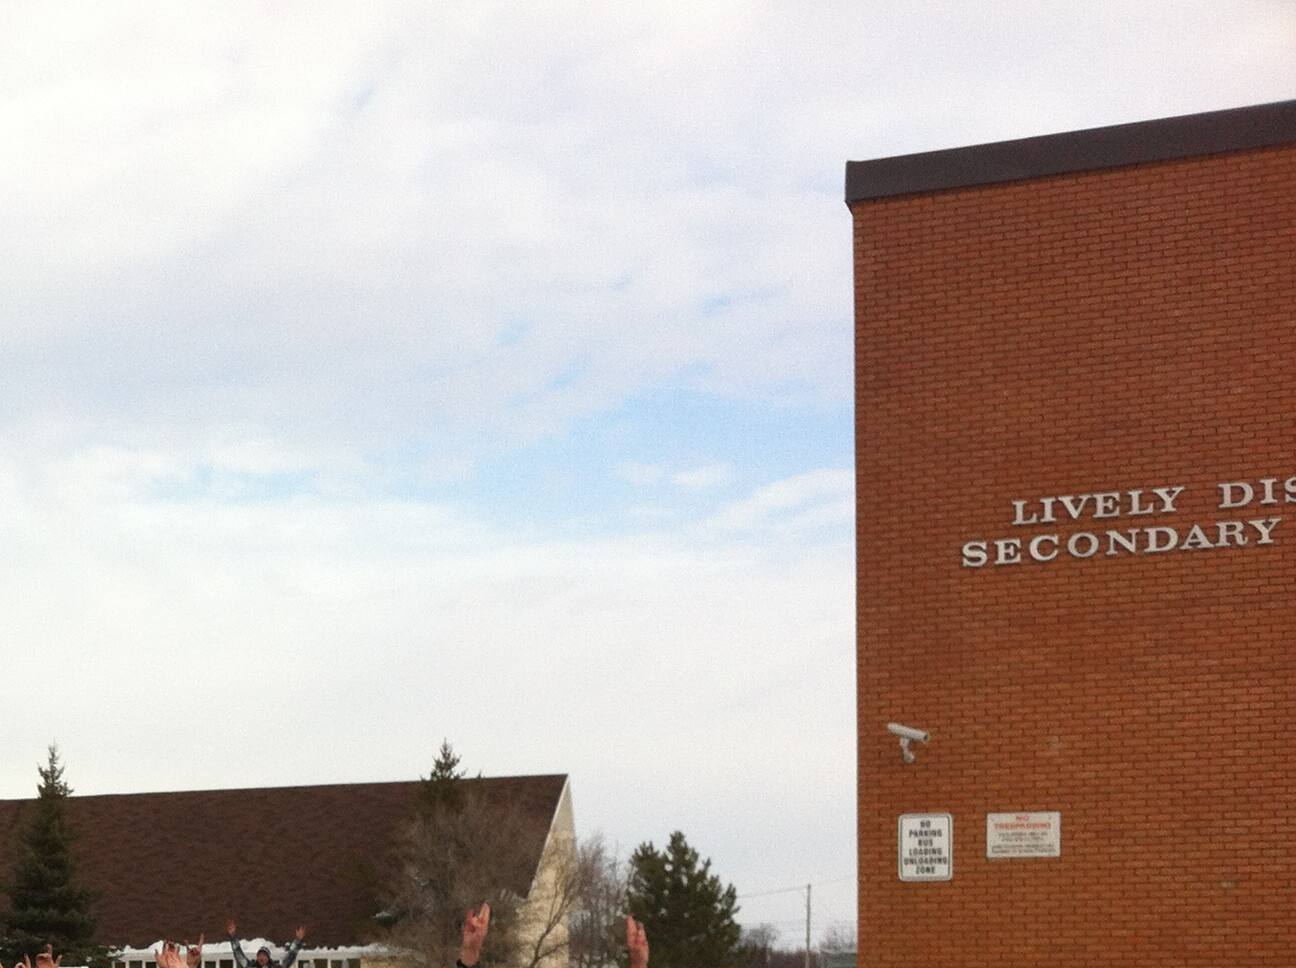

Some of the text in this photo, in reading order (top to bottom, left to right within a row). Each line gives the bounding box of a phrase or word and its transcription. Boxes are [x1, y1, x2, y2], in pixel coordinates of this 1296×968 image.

[1011, 486, 1185, 526] LIVELY
[961, 517, 1282, 568] SECONDARY
[909, 829, 942, 837] PARKING
[909, 848, 943, 856] LOADING
[916, 866, 935, 875] ZONE
